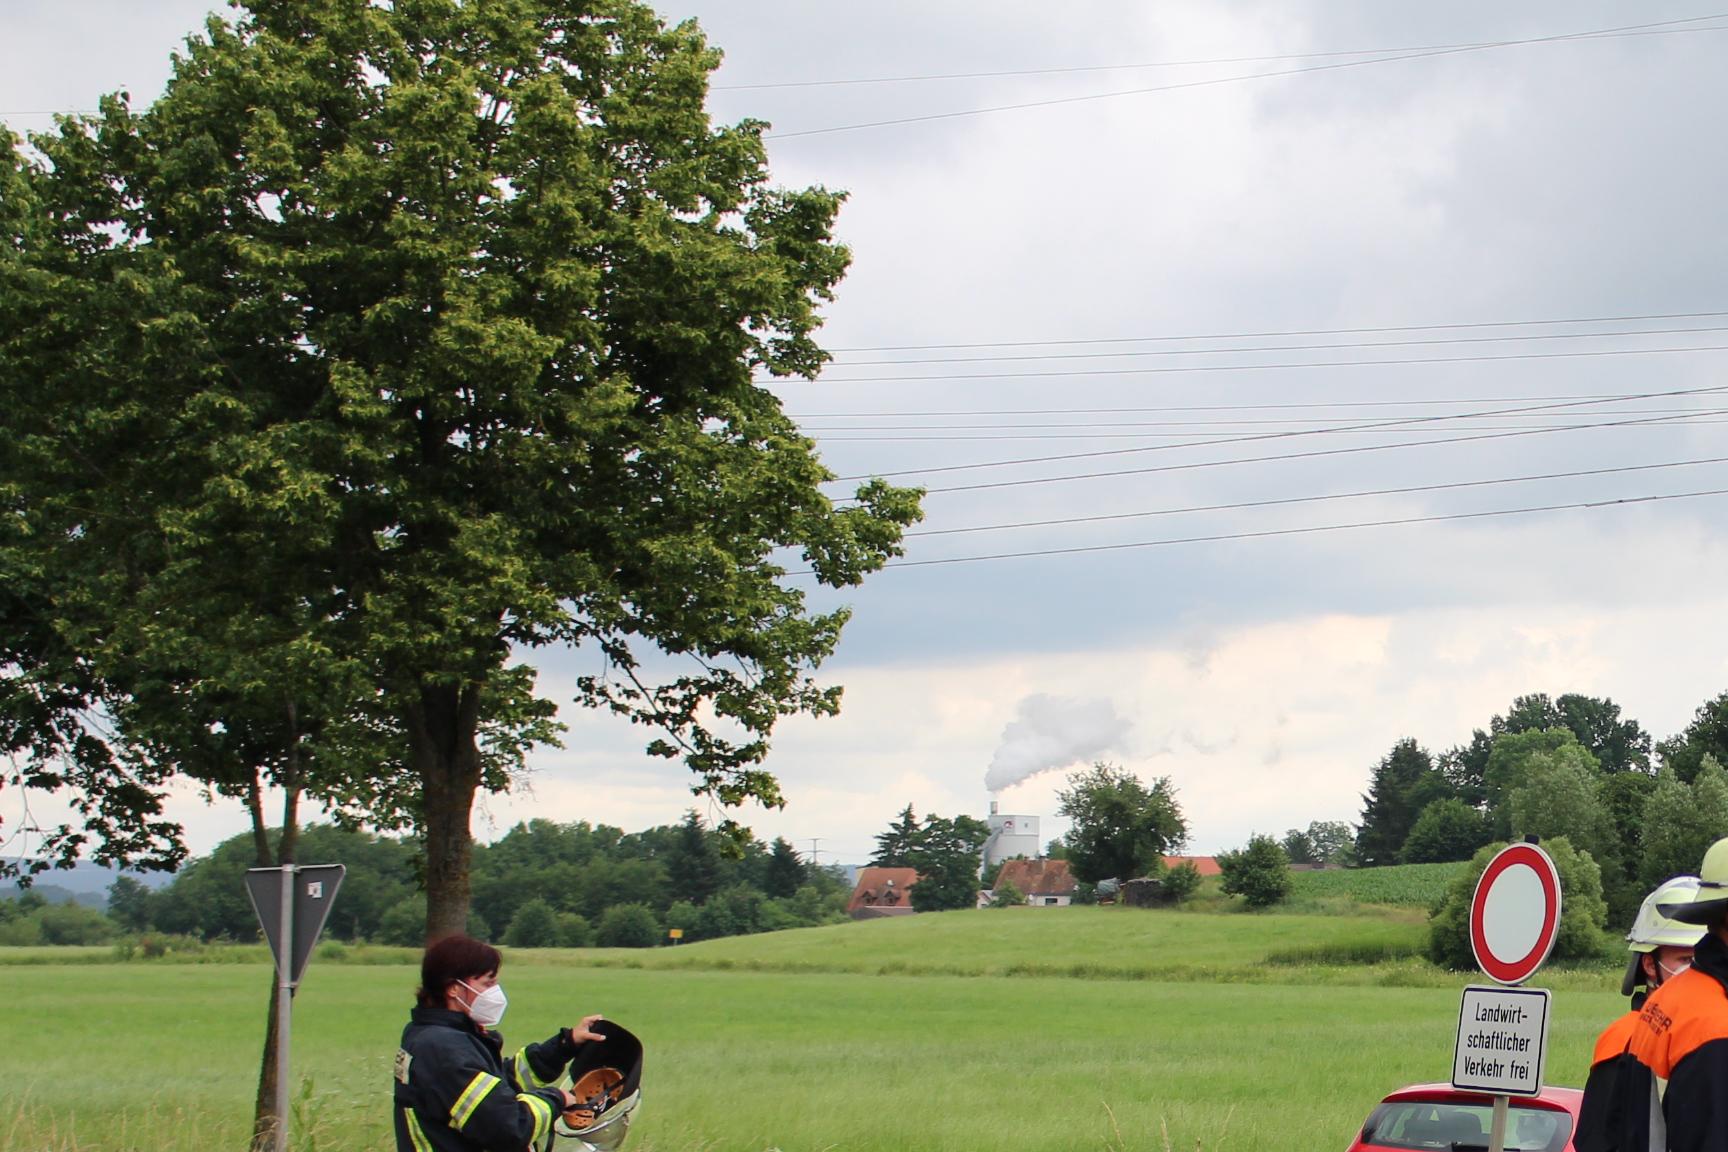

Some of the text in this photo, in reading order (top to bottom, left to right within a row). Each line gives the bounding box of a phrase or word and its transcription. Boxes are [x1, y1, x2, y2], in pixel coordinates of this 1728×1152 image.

[1475, 1002, 1528, 1024] Landwirt-
[1467, 1030, 1531, 1052] schaftlicher
[1464, 1056, 1530, 1080] Verkehr frei
